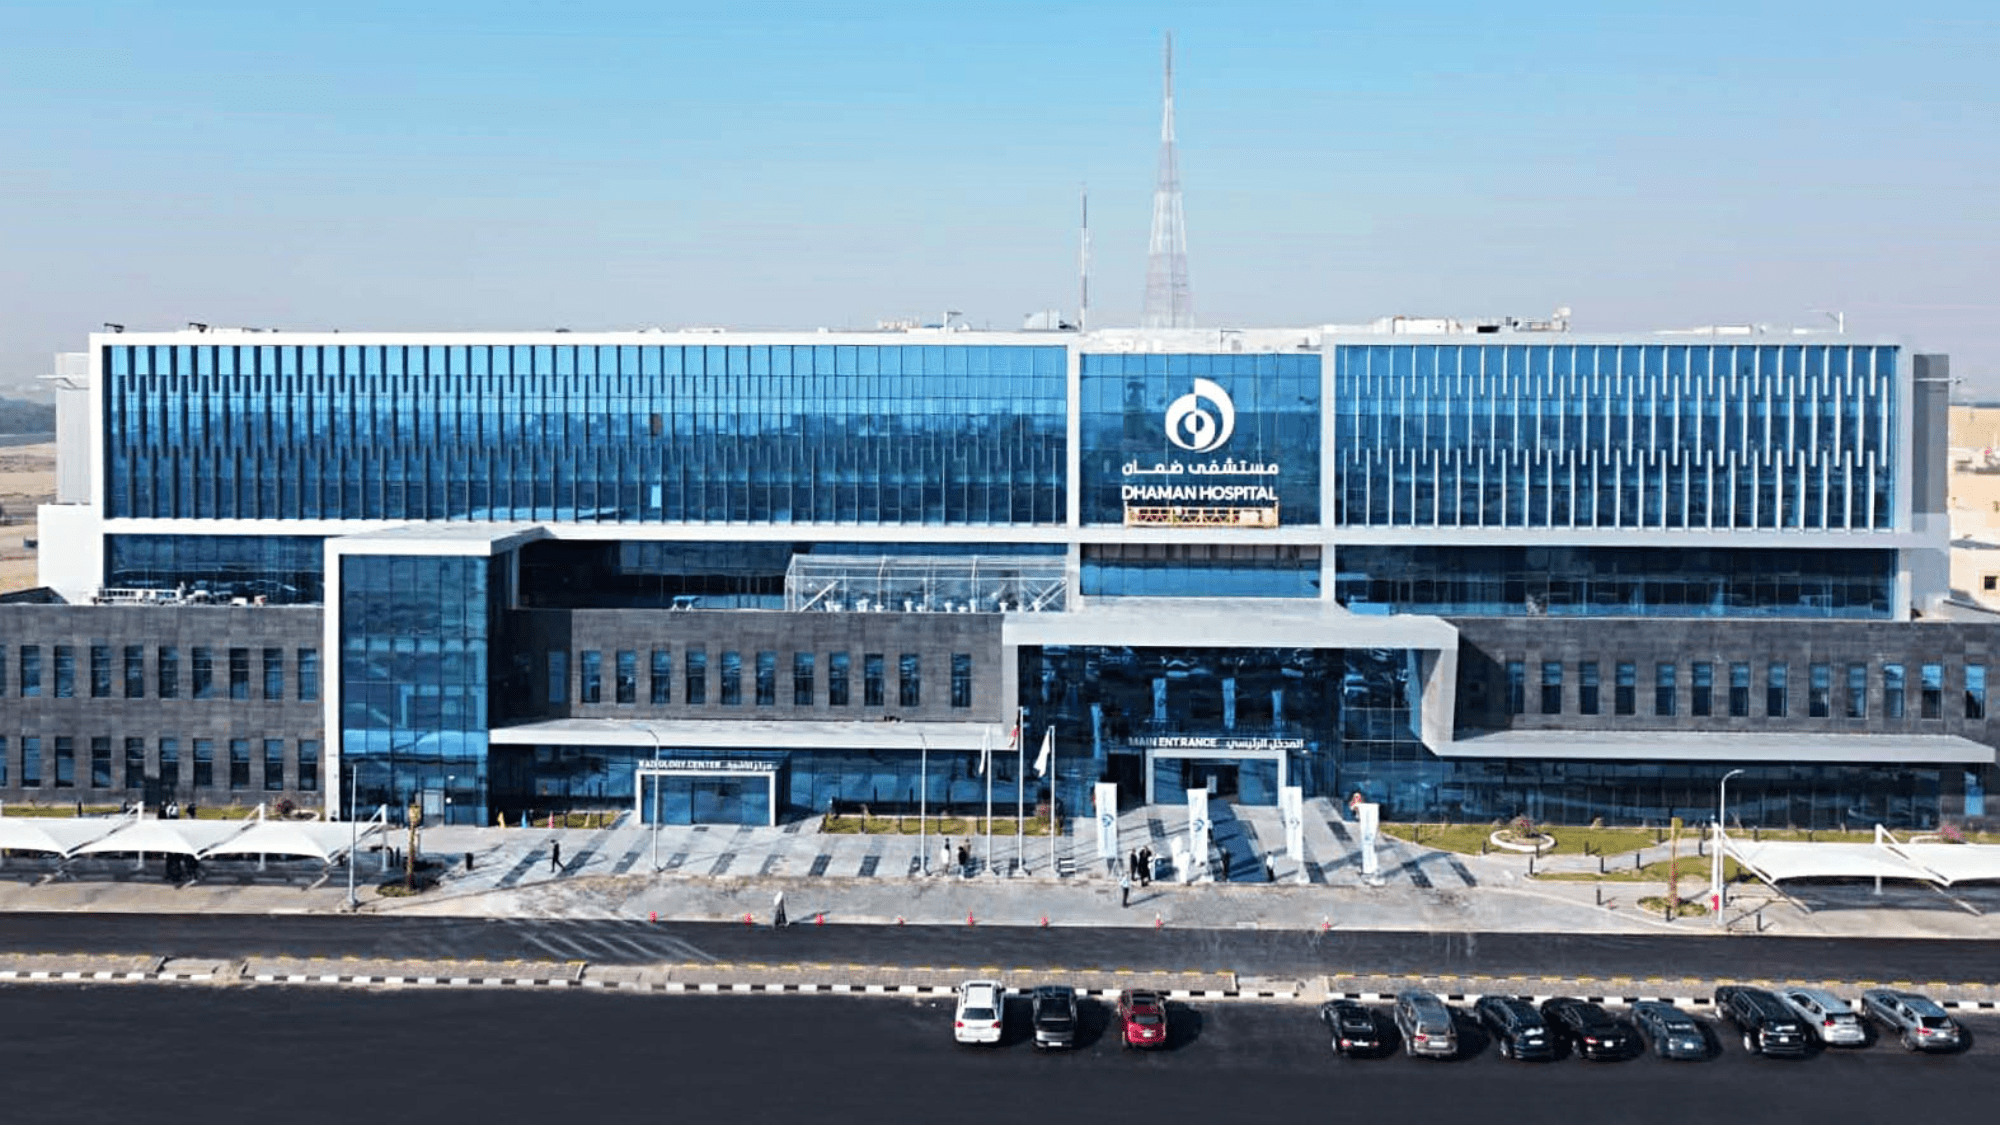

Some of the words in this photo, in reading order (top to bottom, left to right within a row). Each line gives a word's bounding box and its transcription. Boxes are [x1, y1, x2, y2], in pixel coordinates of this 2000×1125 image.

[1122, 458, 1184, 476] ضمان
[1188, 458, 1279, 475] مستشفى
[1121, 486, 1197, 500] DHAMAN
[1199, 486, 1278, 500] HOSPITAL
[1128, 737, 1157, 747] MAIN
[1158, 737, 1217, 748] ENTRANCE
[687, 760, 721, 769] CENTER
